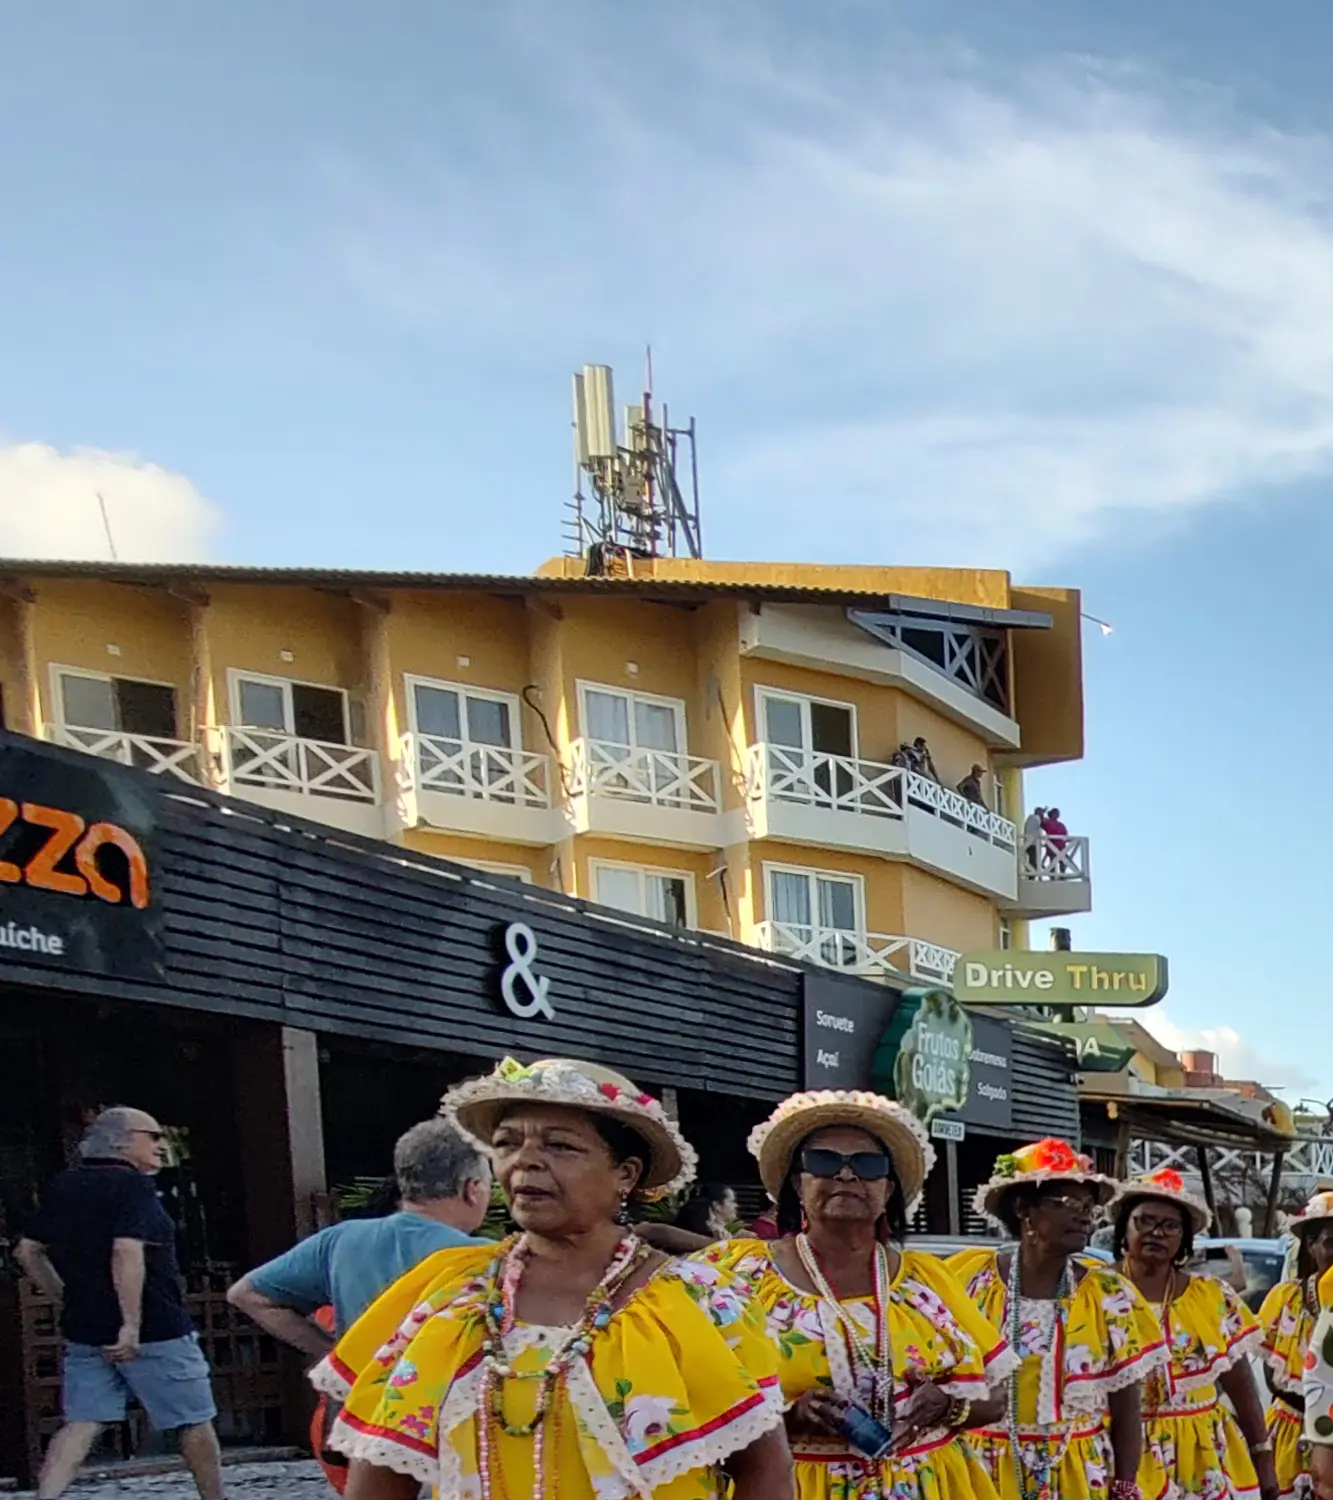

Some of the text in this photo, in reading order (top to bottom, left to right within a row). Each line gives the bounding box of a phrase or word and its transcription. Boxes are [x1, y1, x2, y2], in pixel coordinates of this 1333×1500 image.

[502, 922, 556, 1020] &
[965, 962, 1147, 991] Drive Thru
[918, 1021, 960, 1060] Frutos
[912, 1053, 956, 1096] Goiás
